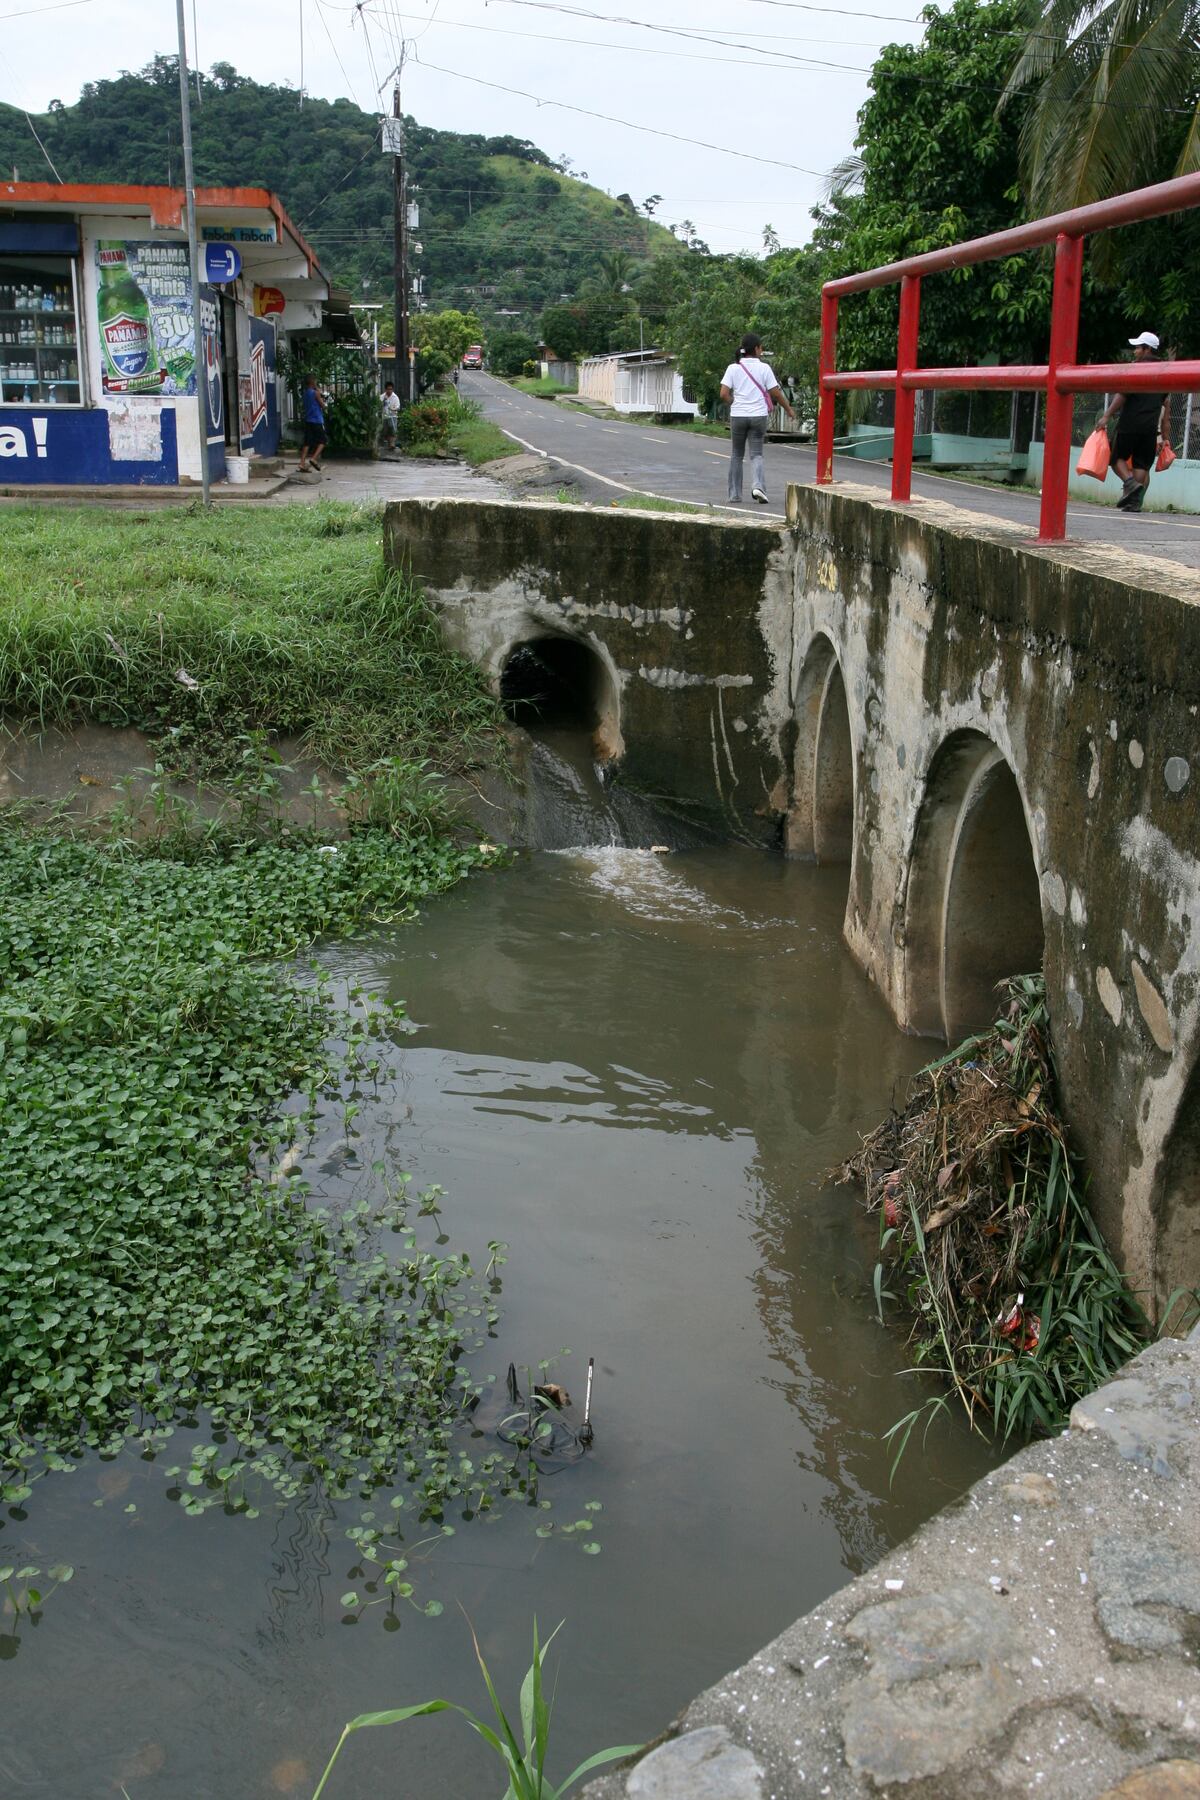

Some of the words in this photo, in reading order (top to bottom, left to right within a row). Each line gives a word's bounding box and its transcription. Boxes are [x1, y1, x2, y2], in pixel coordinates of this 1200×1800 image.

[239, 227, 273, 241] tabcin
[138, 248, 186, 262] PANAMA
[146, 263, 189, 276] orgullosa
[151, 278, 185, 295] Pinta
[121, 357, 144, 371] Lager
